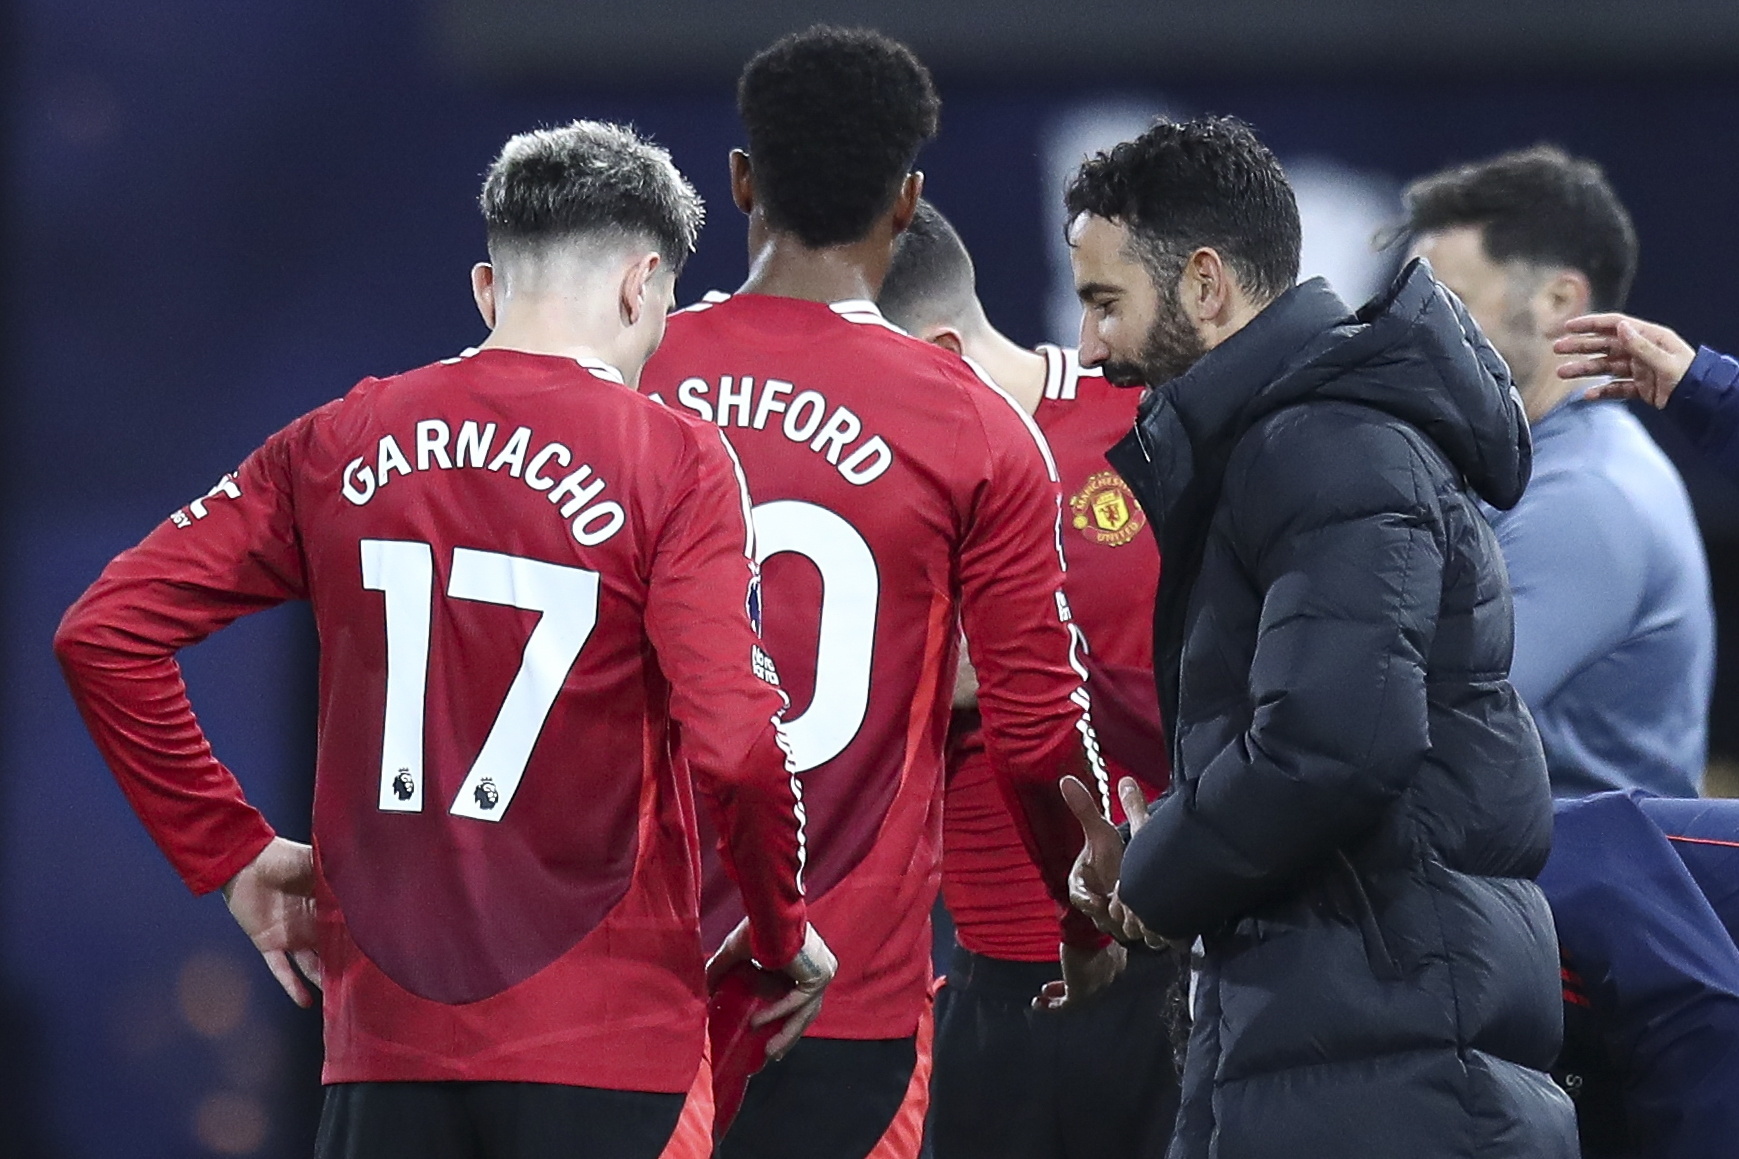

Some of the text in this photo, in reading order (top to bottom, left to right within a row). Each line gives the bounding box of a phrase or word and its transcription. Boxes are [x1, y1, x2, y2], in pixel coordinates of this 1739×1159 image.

[341, 419, 626, 547] GARNACHO
[648, 375, 893, 486] SHFORD
[1097, 521, 1140, 542] UNITED
[360, 538, 601, 823] 17
